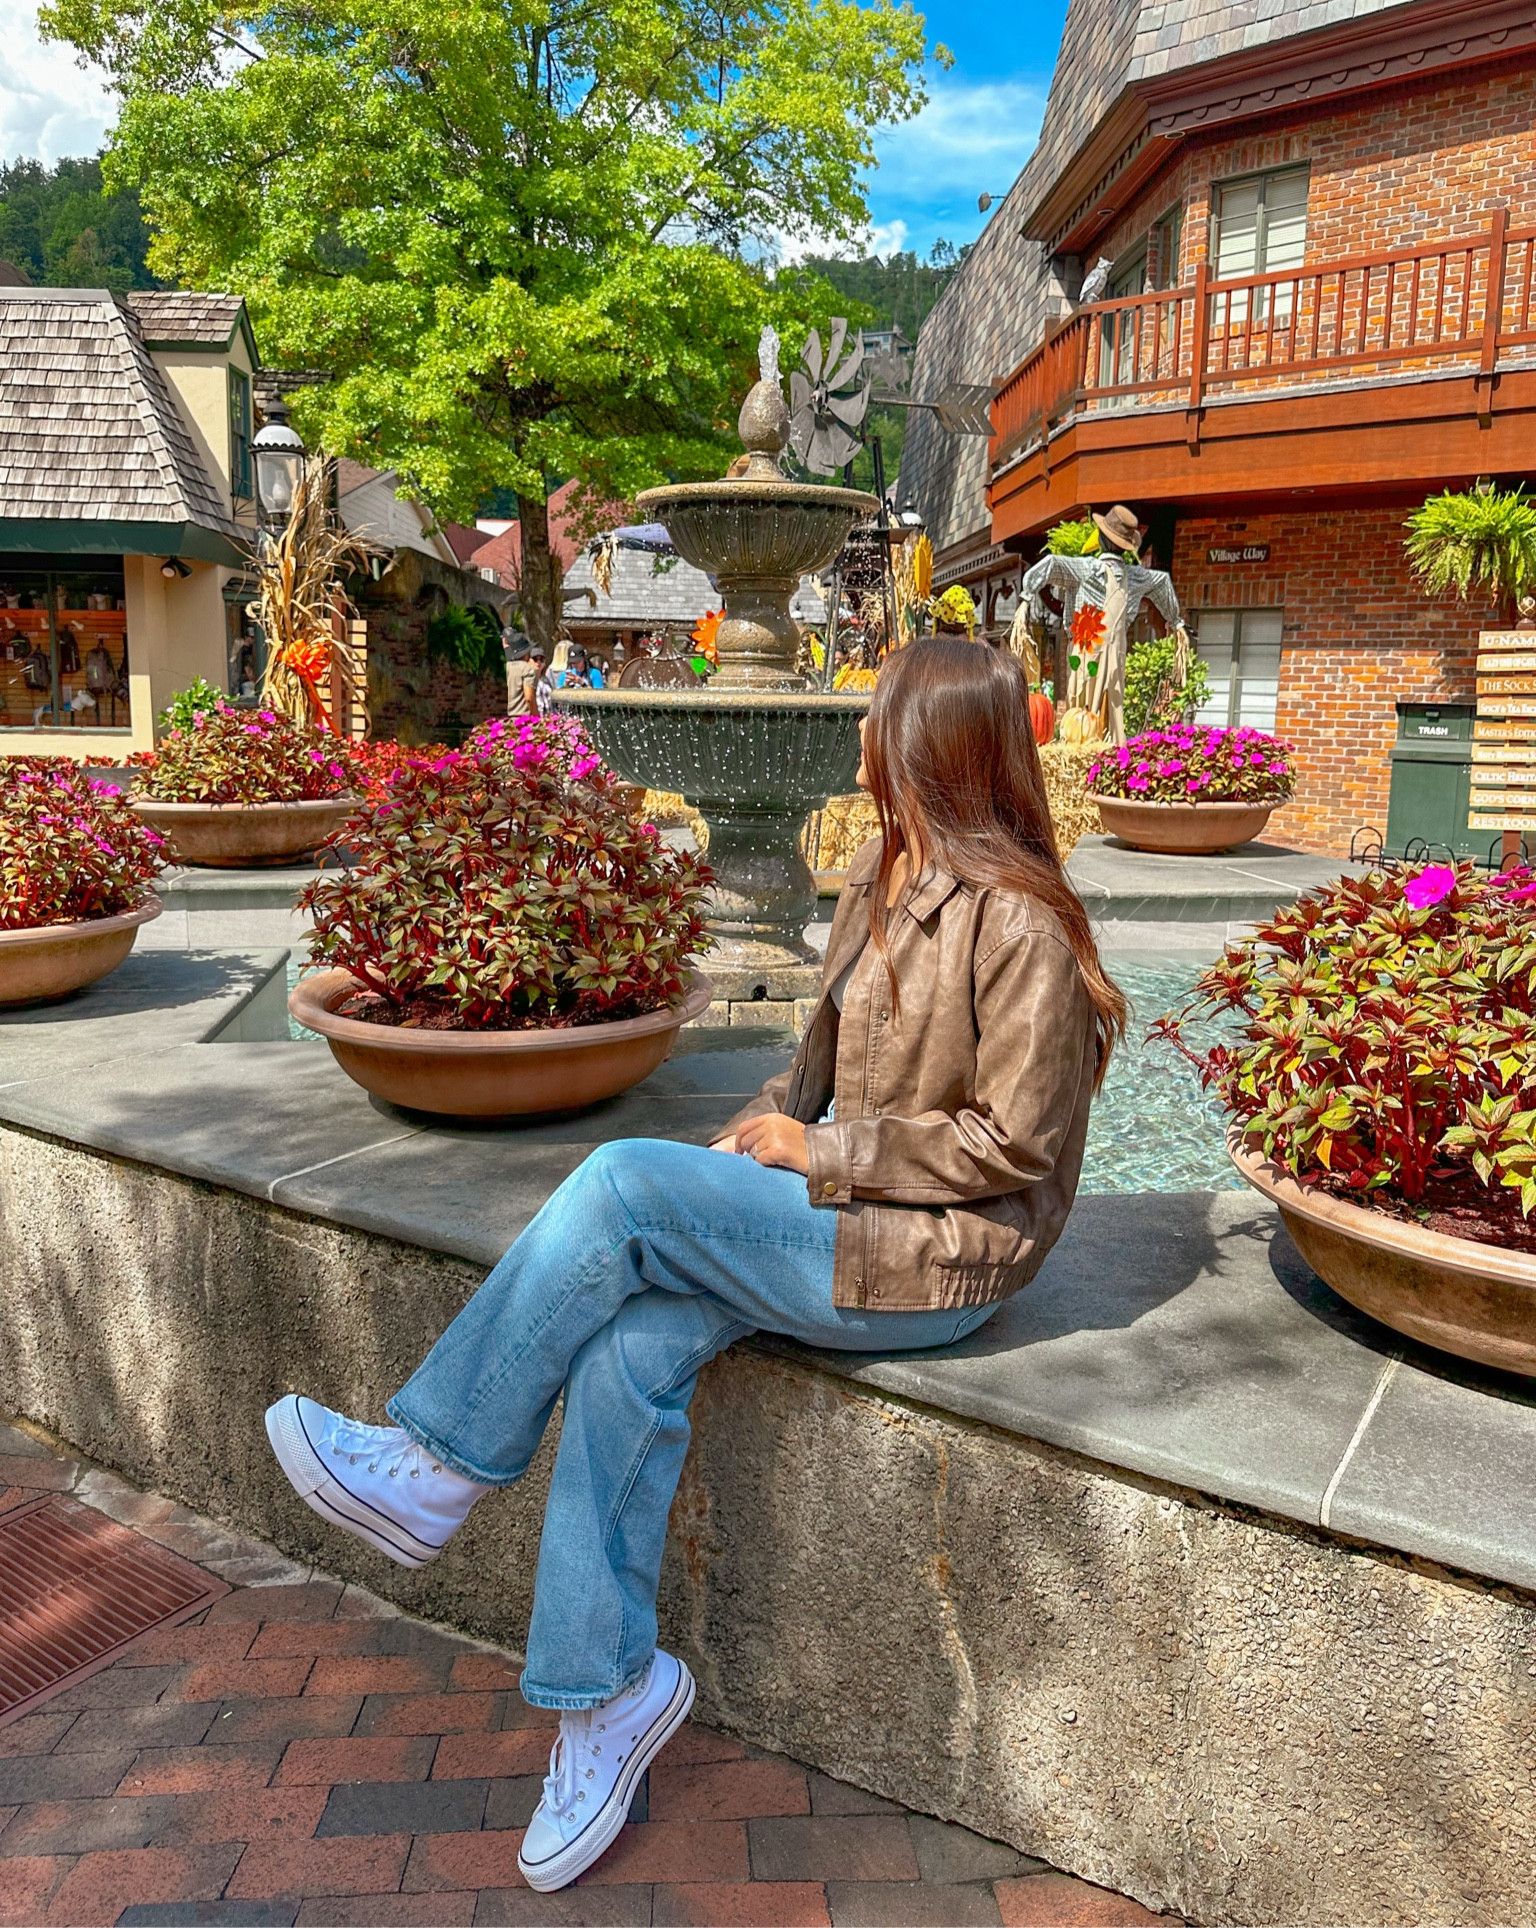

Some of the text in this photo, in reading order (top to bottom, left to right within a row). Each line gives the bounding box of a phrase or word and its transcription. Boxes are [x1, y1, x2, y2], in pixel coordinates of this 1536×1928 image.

[1209, 547, 1267, 562] Village Way
[1482, 680, 1502, 691] THE
[1503, 679, 1531, 691] SOCK
[1418, 726, 1449, 735] TRASH
[1474, 771, 1507, 782] CELTIC
[1473, 793, 1504, 804] GOD'S
